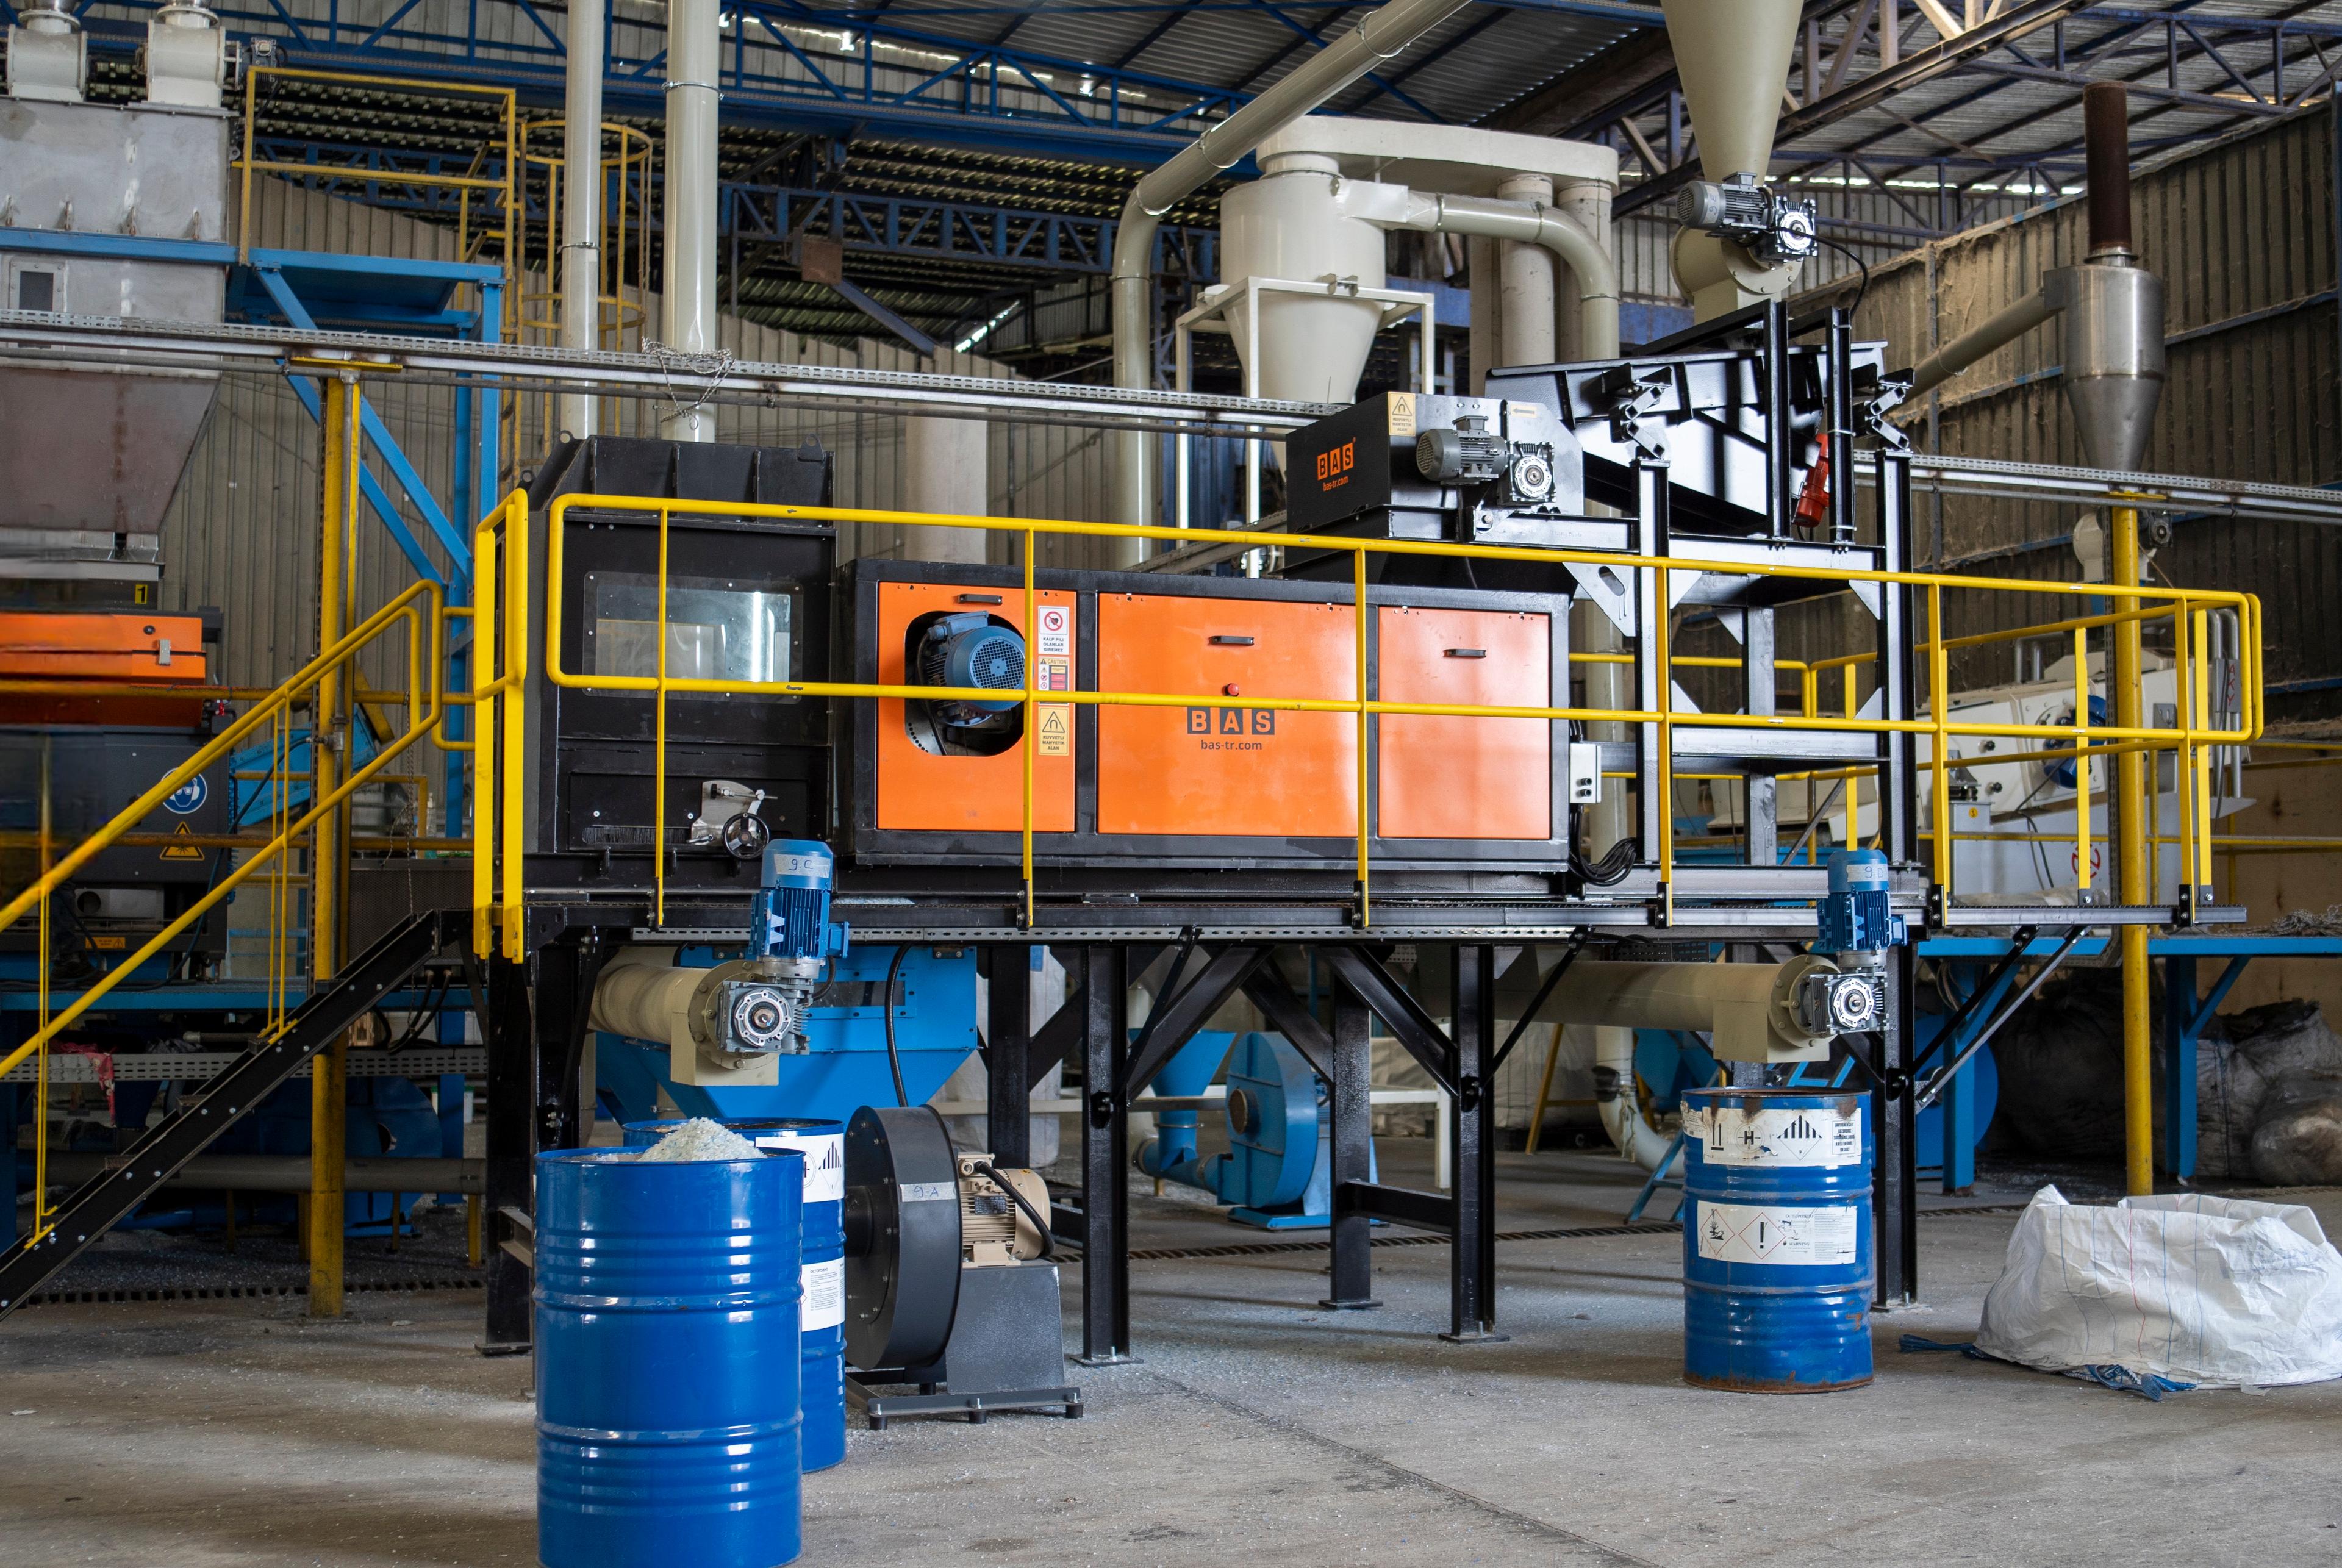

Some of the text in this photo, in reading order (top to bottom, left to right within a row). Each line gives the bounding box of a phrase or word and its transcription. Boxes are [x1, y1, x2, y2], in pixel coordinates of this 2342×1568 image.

[1319, 446, 1352, 477] BAS
[1323, 476, 1348, 492] bas-tr.com
[137, 586, 146, 603] 1
[1190, 709, 1272, 732] BAS
[1201, 740, 1262, 750] bas-tr.com
[1744, 1131, 1754, 1145] H
